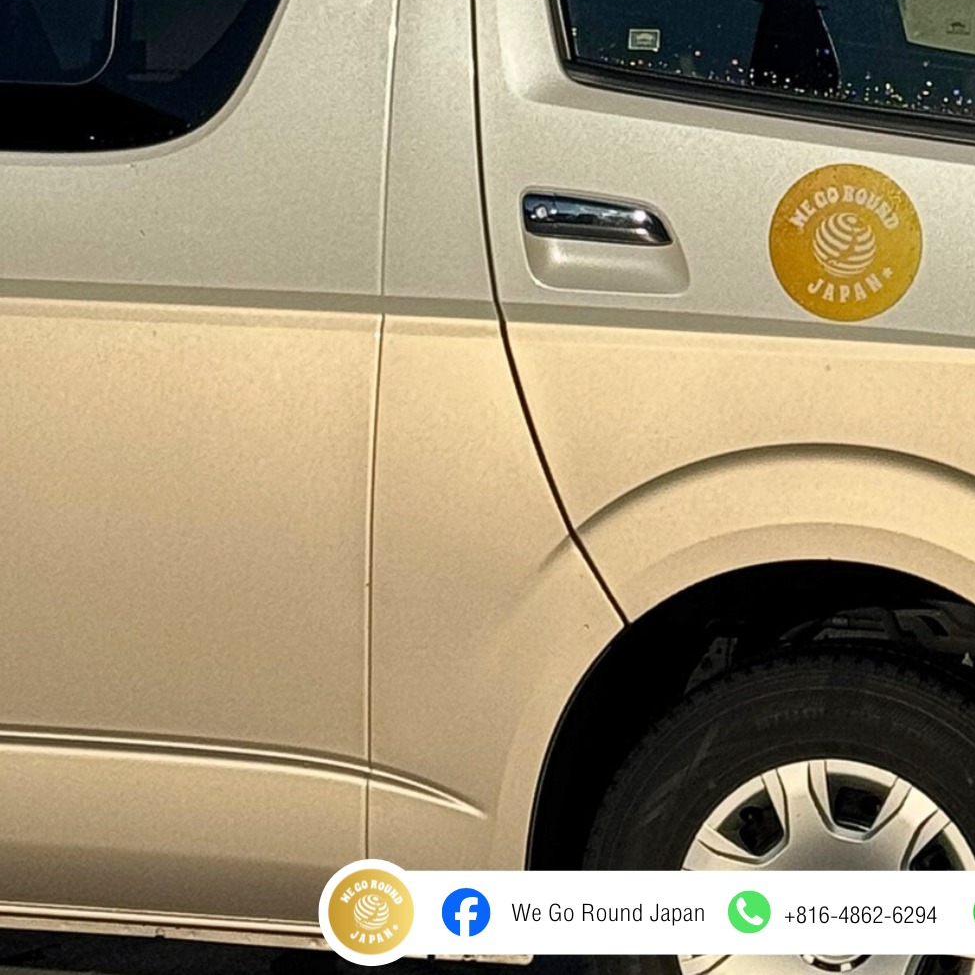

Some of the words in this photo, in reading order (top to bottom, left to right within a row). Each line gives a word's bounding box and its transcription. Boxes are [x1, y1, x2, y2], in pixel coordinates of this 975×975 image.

[789, 199, 816, 234] WE
[814, 187, 840, 208] GO
[843, 185, 900, 230] ROUND
[807, 274, 883, 303] JAPAN
